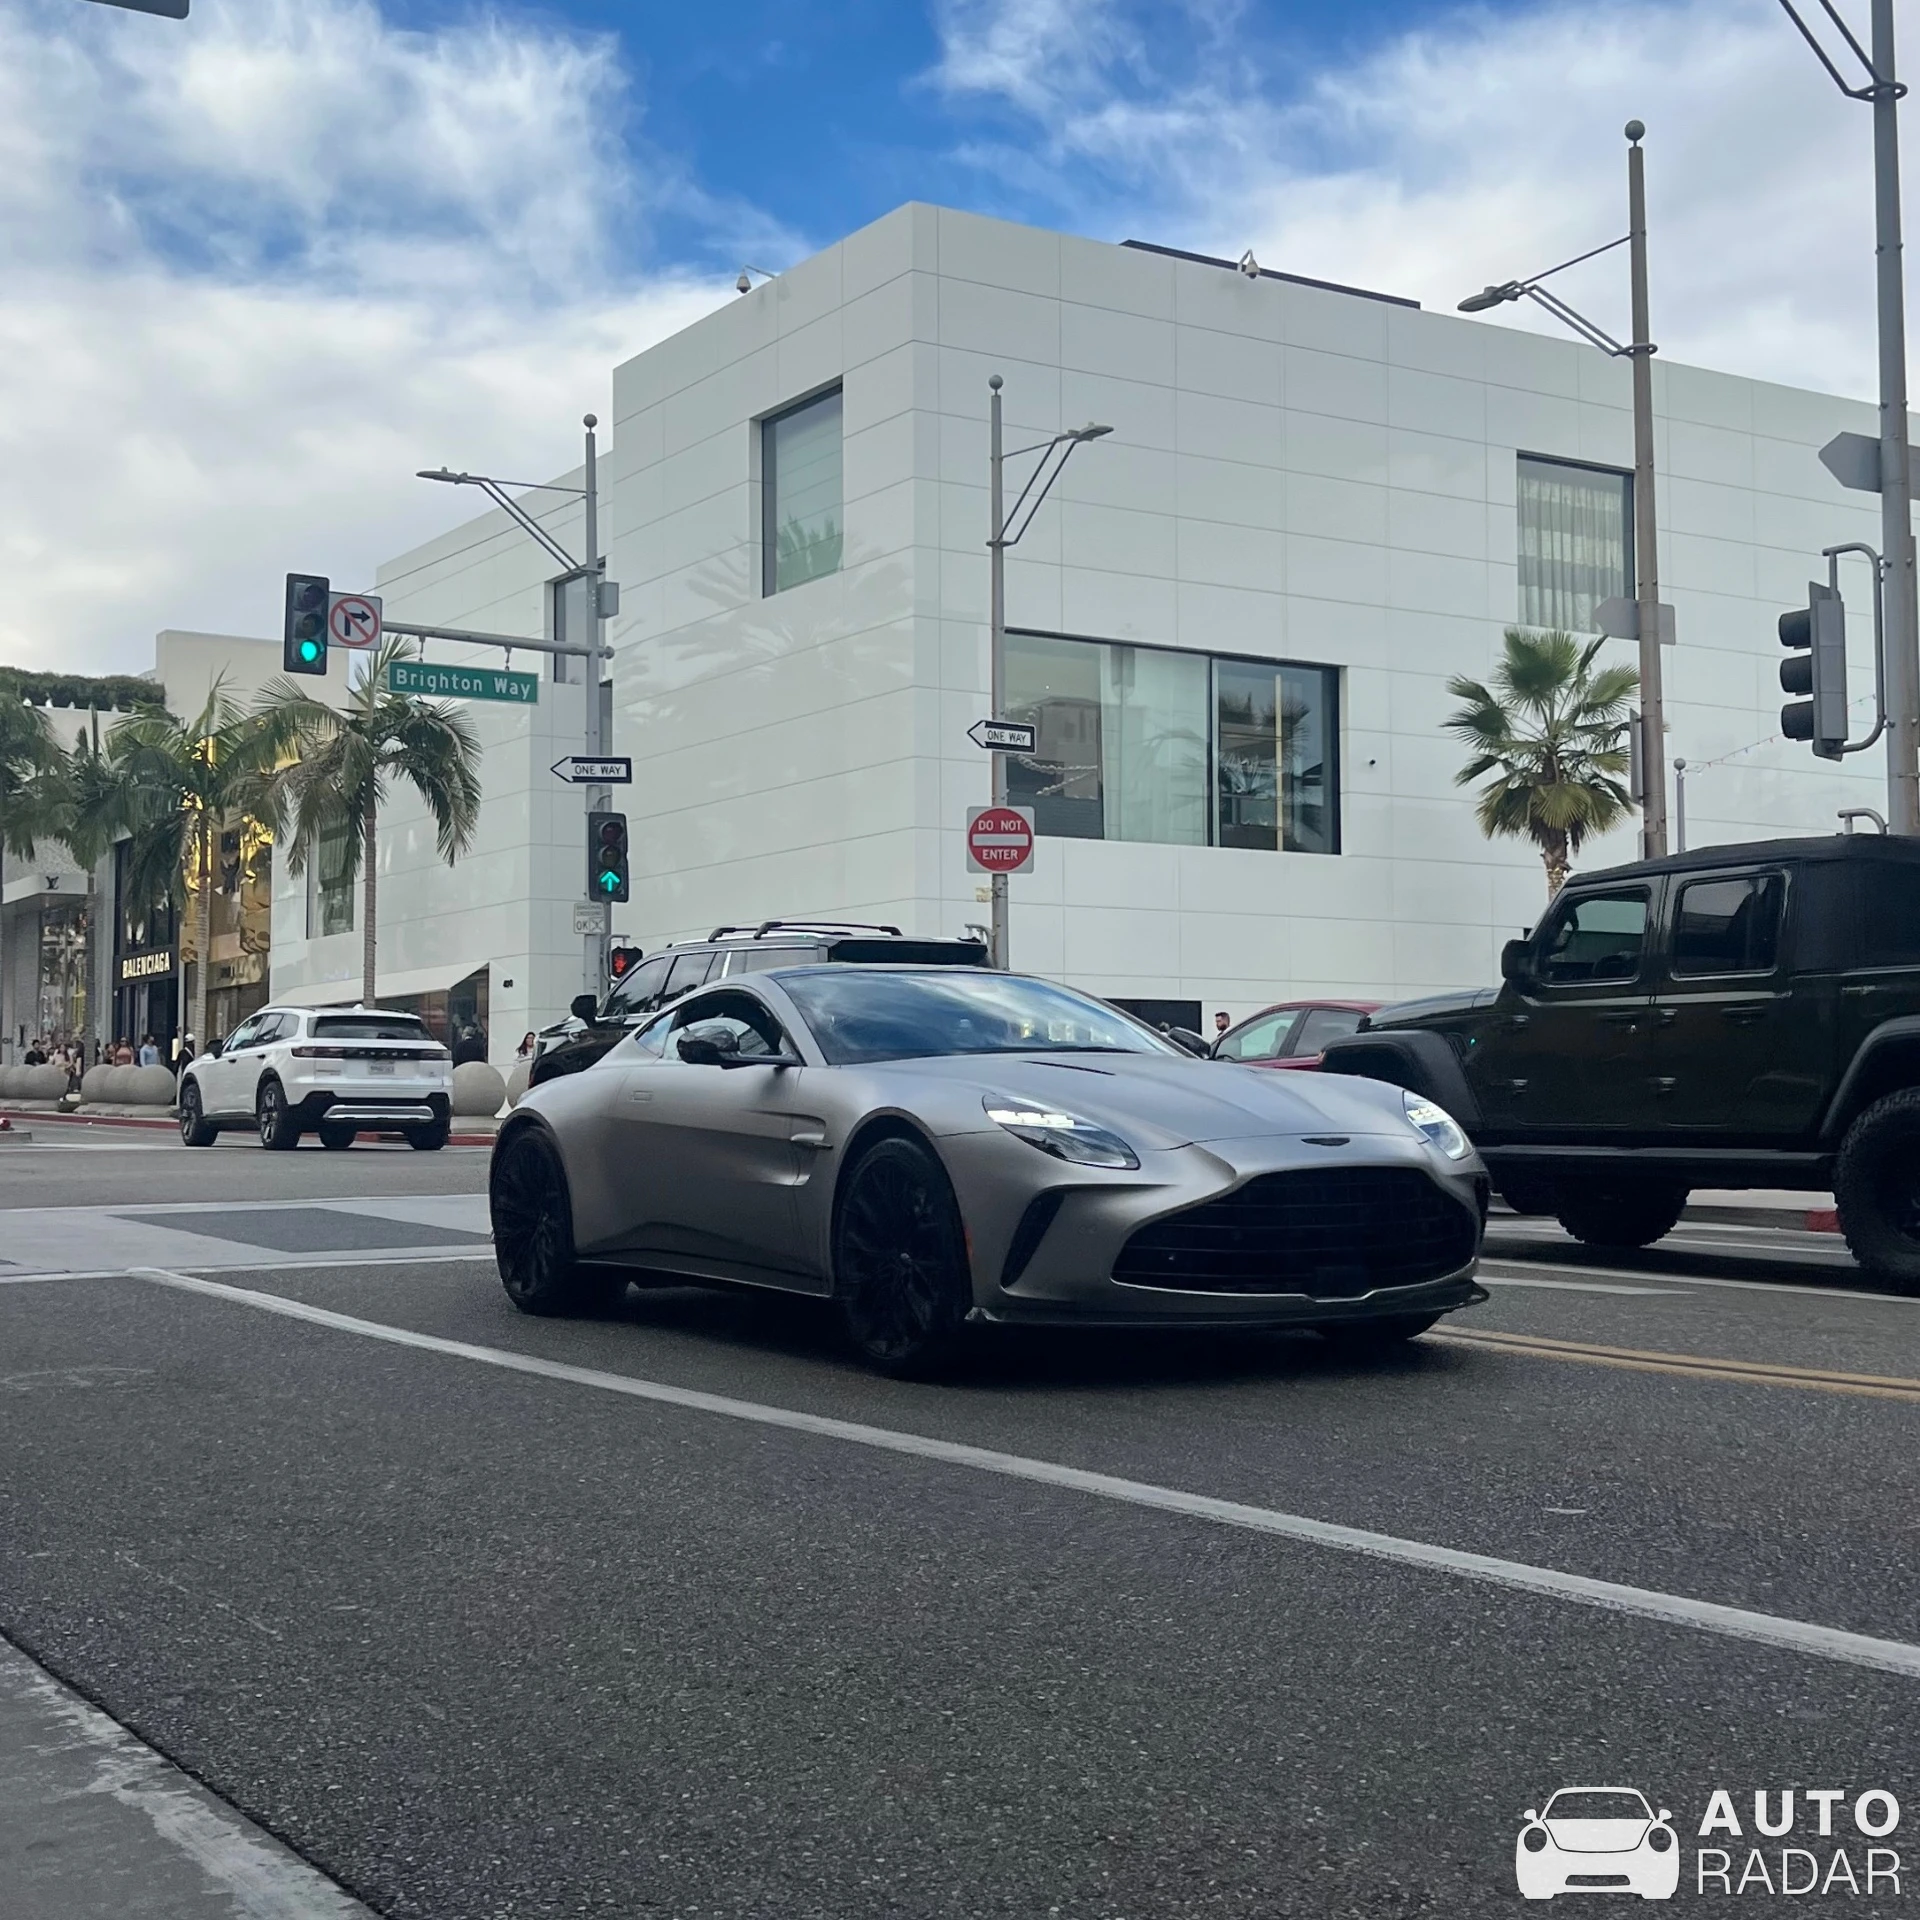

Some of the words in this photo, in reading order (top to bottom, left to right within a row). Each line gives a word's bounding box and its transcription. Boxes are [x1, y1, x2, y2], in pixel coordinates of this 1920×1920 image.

[396, 668, 482, 693] Brighton
[494, 677, 531, 700] Way
[987, 730, 1005, 742] ONE
[1009, 732, 1027, 743] WAY
[574, 764, 596, 775] ONE
[600, 765, 621, 775] WAY
[978, 820, 994, 831] DO
[1001, 820, 1022, 831] NOT
[982, 849, 1018, 860] ENTER
[122, 951, 170, 979] BALENCIAGA
